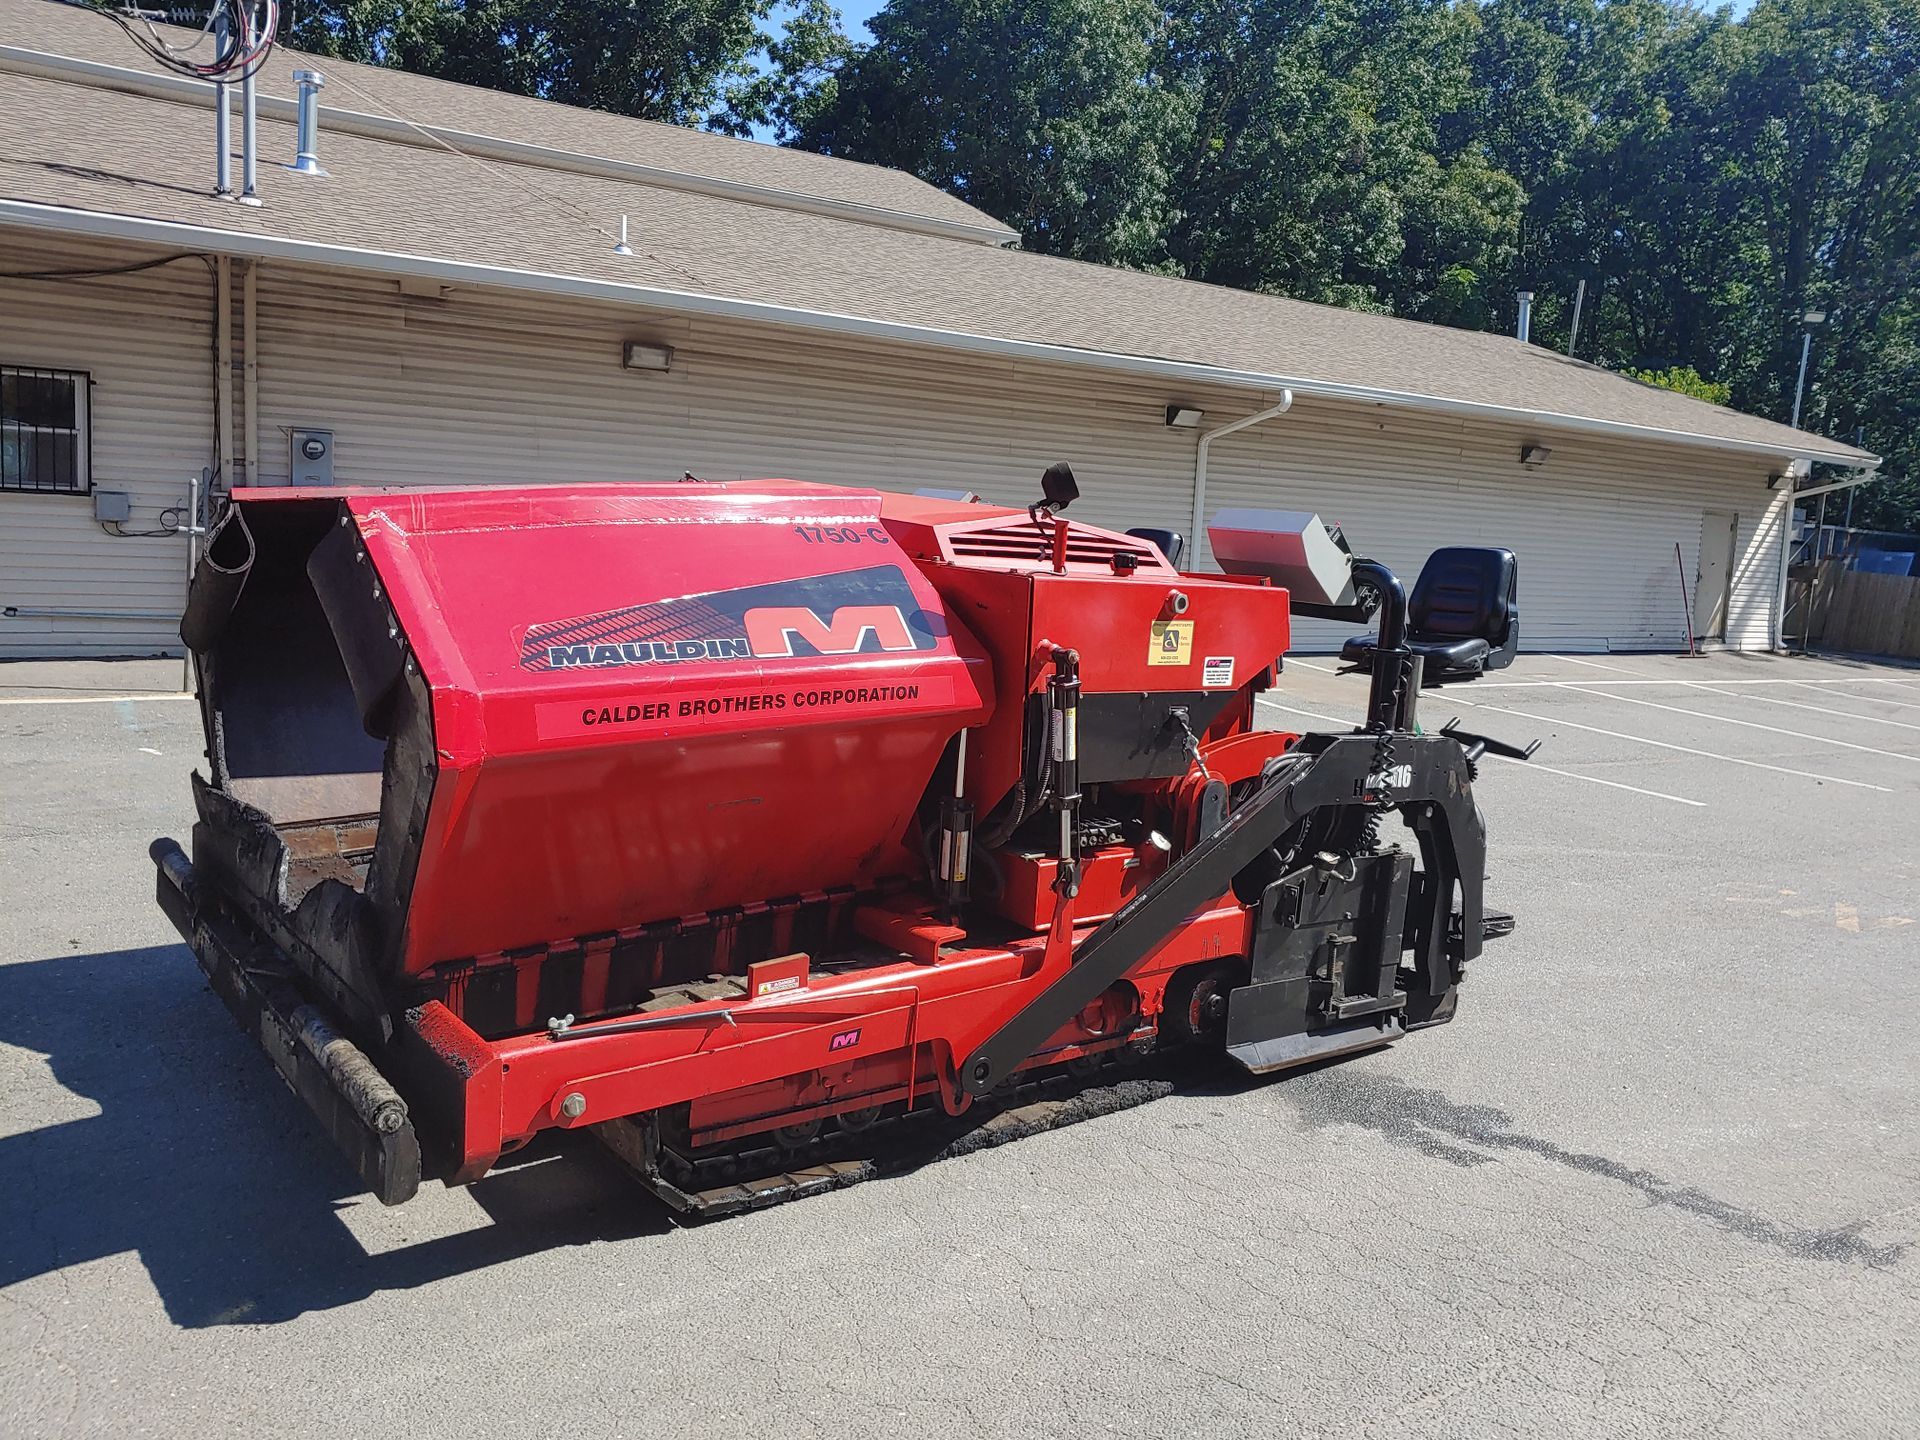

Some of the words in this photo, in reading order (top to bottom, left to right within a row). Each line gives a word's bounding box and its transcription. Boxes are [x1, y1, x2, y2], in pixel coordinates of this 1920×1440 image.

[794, 526, 890, 545] 1750-C
[743, 605, 917, 658] M
[550, 638, 750, 667] MAULDIN
[582, 703, 670, 726] CALDER
[679, 693, 787, 716] BROTHERS
[793, 686, 920, 707] CORPORATION
[833, 1031, 858, 1049] M
